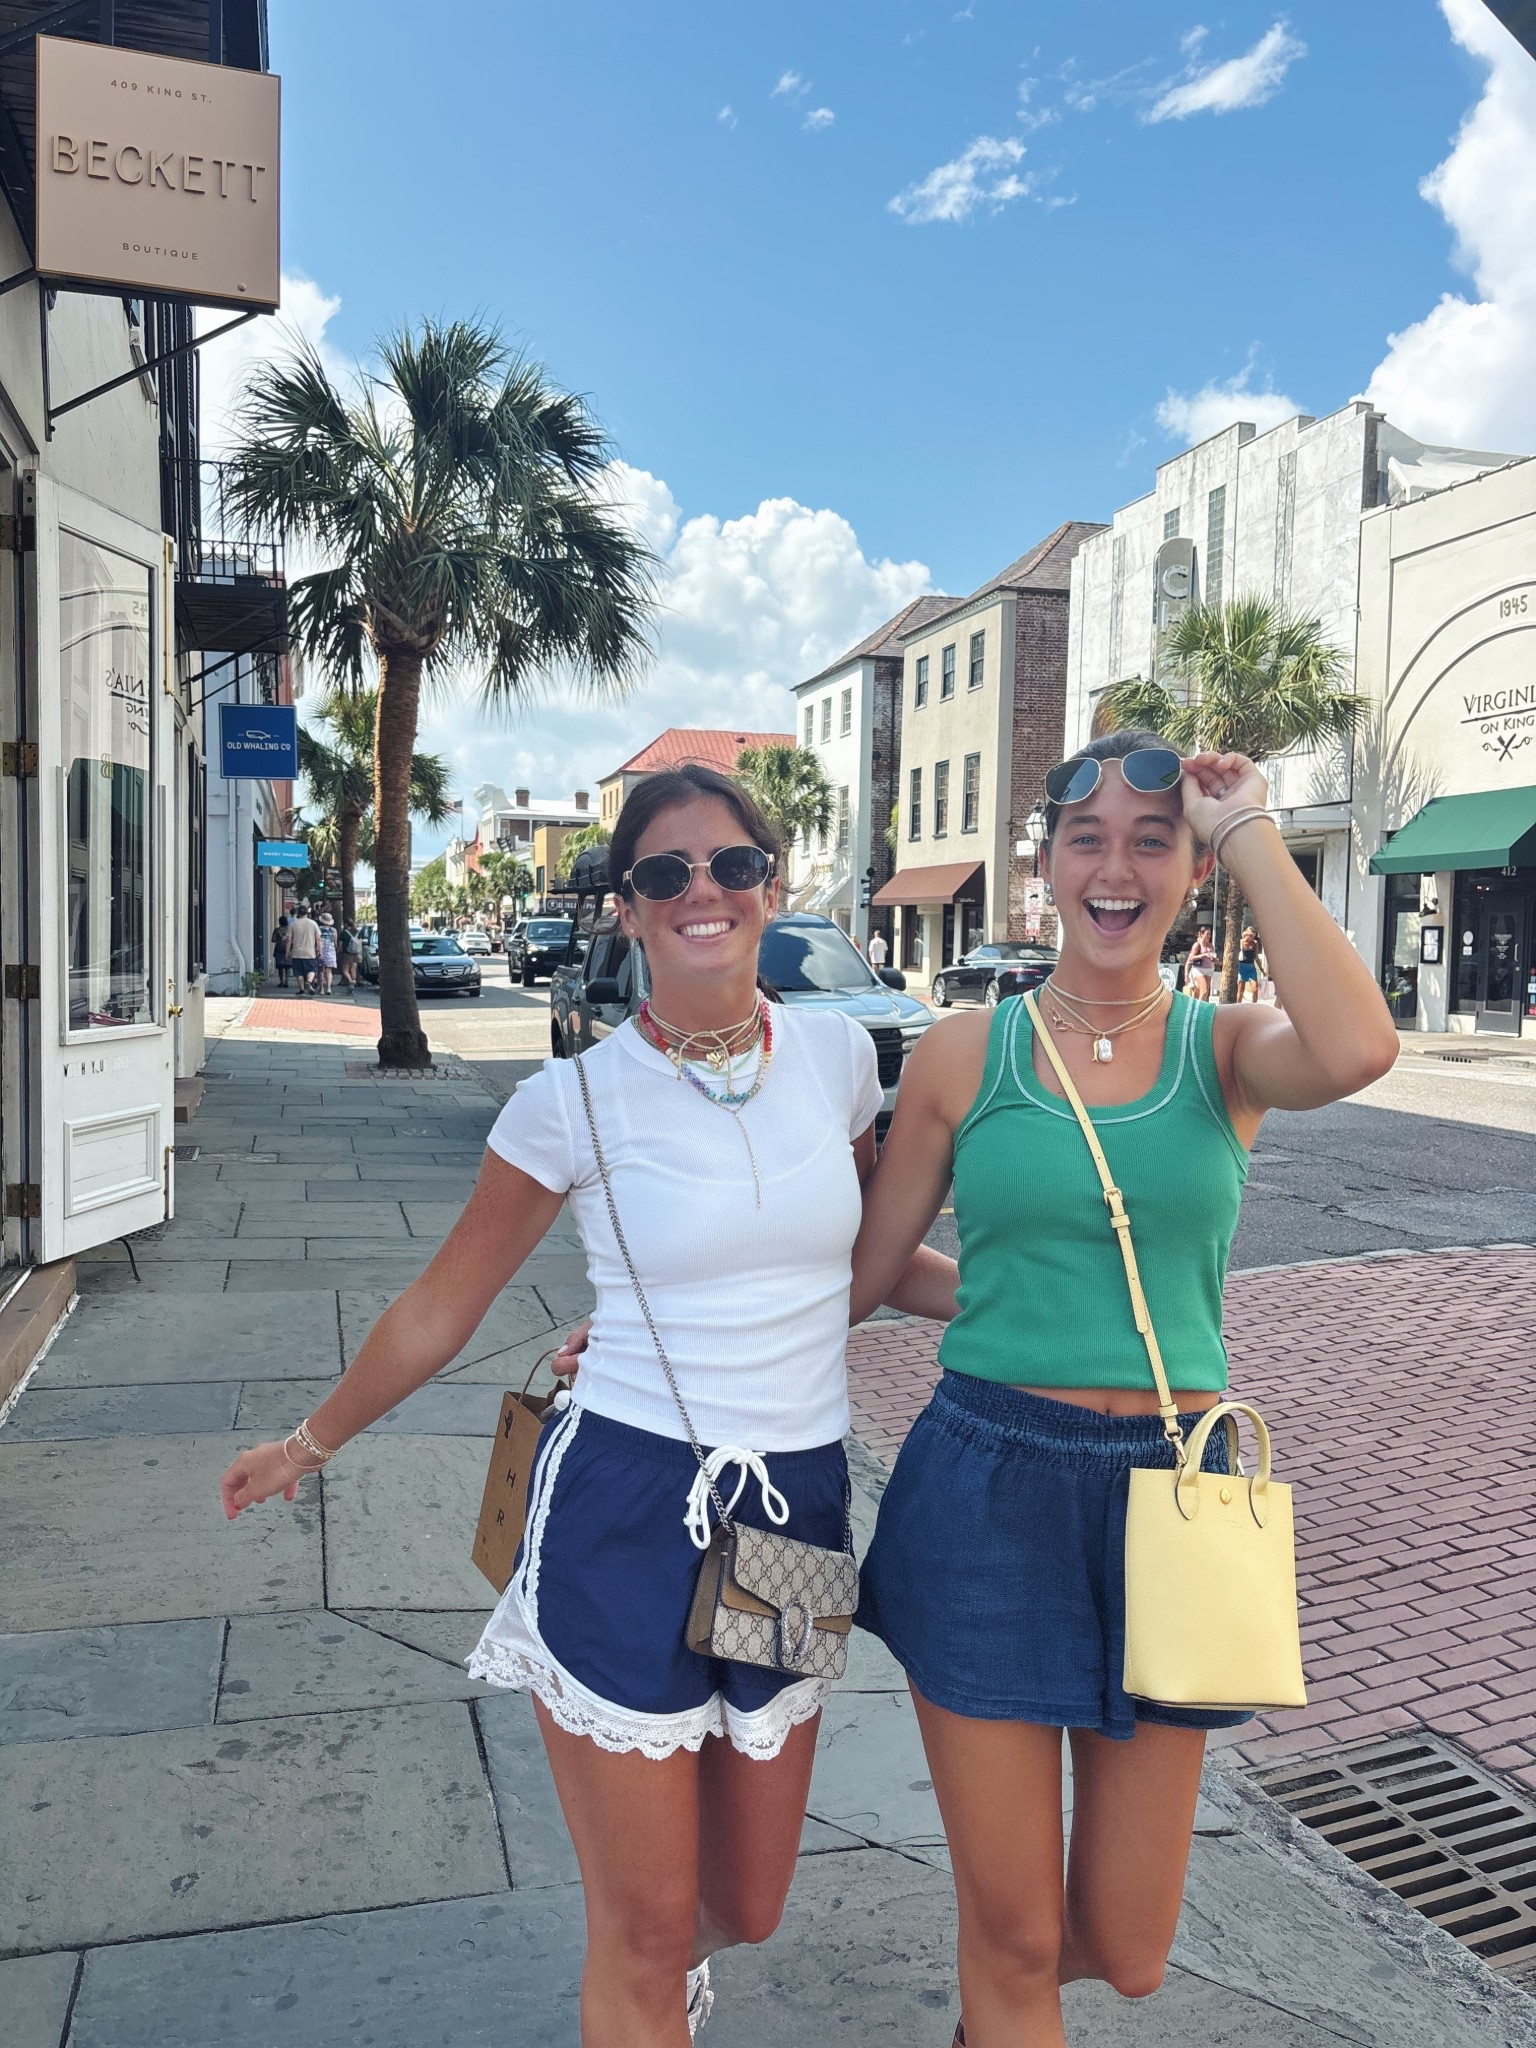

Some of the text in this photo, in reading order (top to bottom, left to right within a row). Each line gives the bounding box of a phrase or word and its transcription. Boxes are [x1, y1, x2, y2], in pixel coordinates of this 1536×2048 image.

[110, 78, 213, 104] 409 KING ST.
[51, 134, 266, 203] BECKETT
[122, 242, 199, 260] BOUTIQUE
[1499, 594, 1528, 619] 1945
[1463, 685, 1536, 715] VIRGINI
[1480, 715, 1535, 735] ON KING
[227, 741, 242, 750] OLD
[243, 742, 279, 750] WHALING
[1500, 865, 1517, 877] 412
